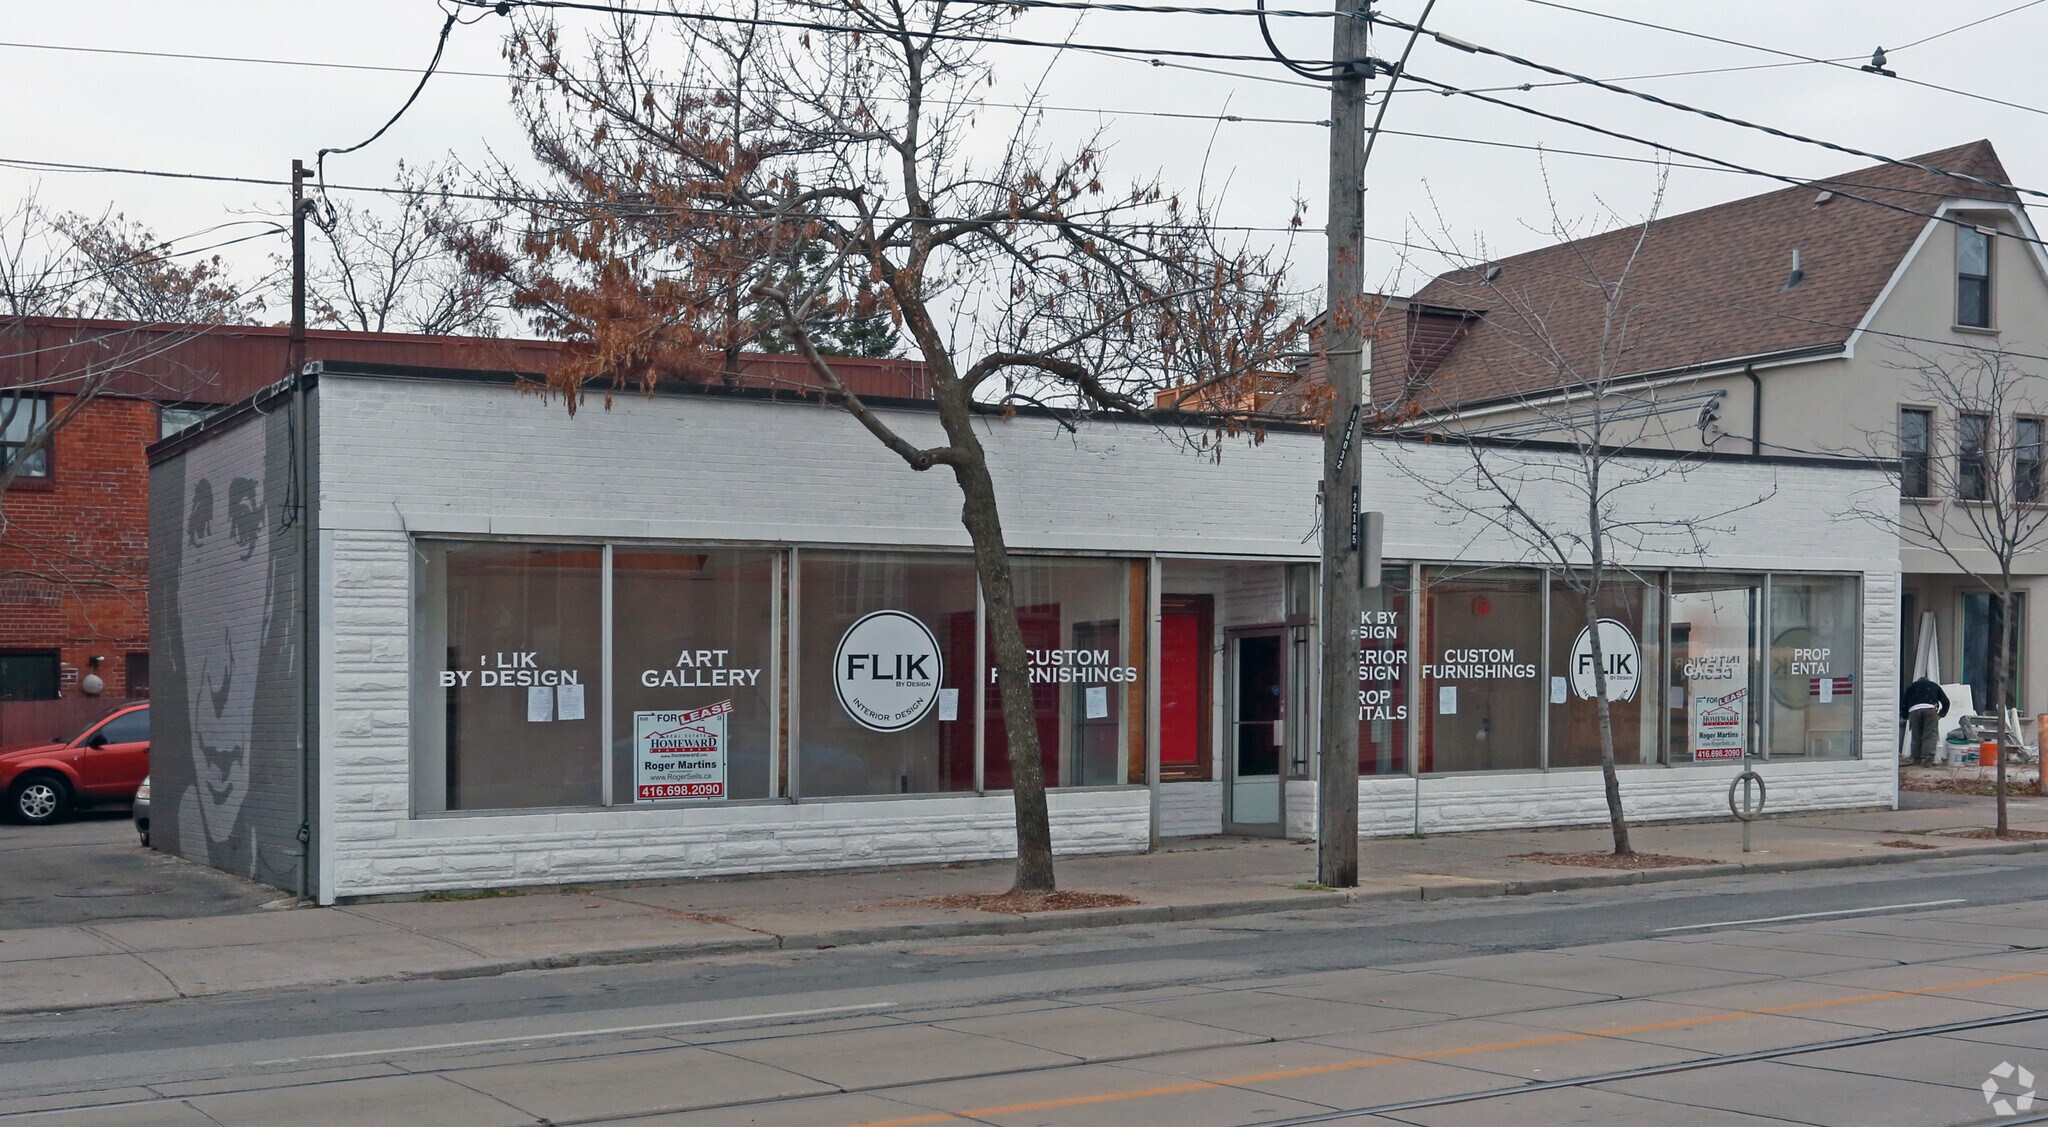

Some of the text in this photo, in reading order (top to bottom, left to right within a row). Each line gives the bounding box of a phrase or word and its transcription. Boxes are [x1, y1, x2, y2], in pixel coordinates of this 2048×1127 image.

[1377, 612, 1397, 624] BY
[1360, 626, 1397, 639] SIGN
[676, 650, 728, 667] ART
[1026, 650, 1109, 665] CUSTOM
[1444, 649, 1514, 663] CUSTOM
[1794, 649, 1830, 661] PROP
[847, 654, 930, 680] FLIK
[1579, 654, 1632, 674] FIK
[439, 670, 578, 687] BY DESIGN
[641, 669, 761, 687] GALLERY
[1359, 666, 1400, 680] SIGN
[1422, 665, 1536, 678] FURNISHINGS
[657, 701, 732, 725] FOR LEASE
[853, 697, 890, 721] INTERIOR
[895, 697, 924, 720] DESIGN
[651, 738, 717, 748] HOMEWARD
[1699, 732, 1716, 740] Roger
[645, 760, 717, 771] Roger Martins
[650, 773, 712, 781] www.RogerSells.ca
[642, 784, 720, 796] 416.698.2090
